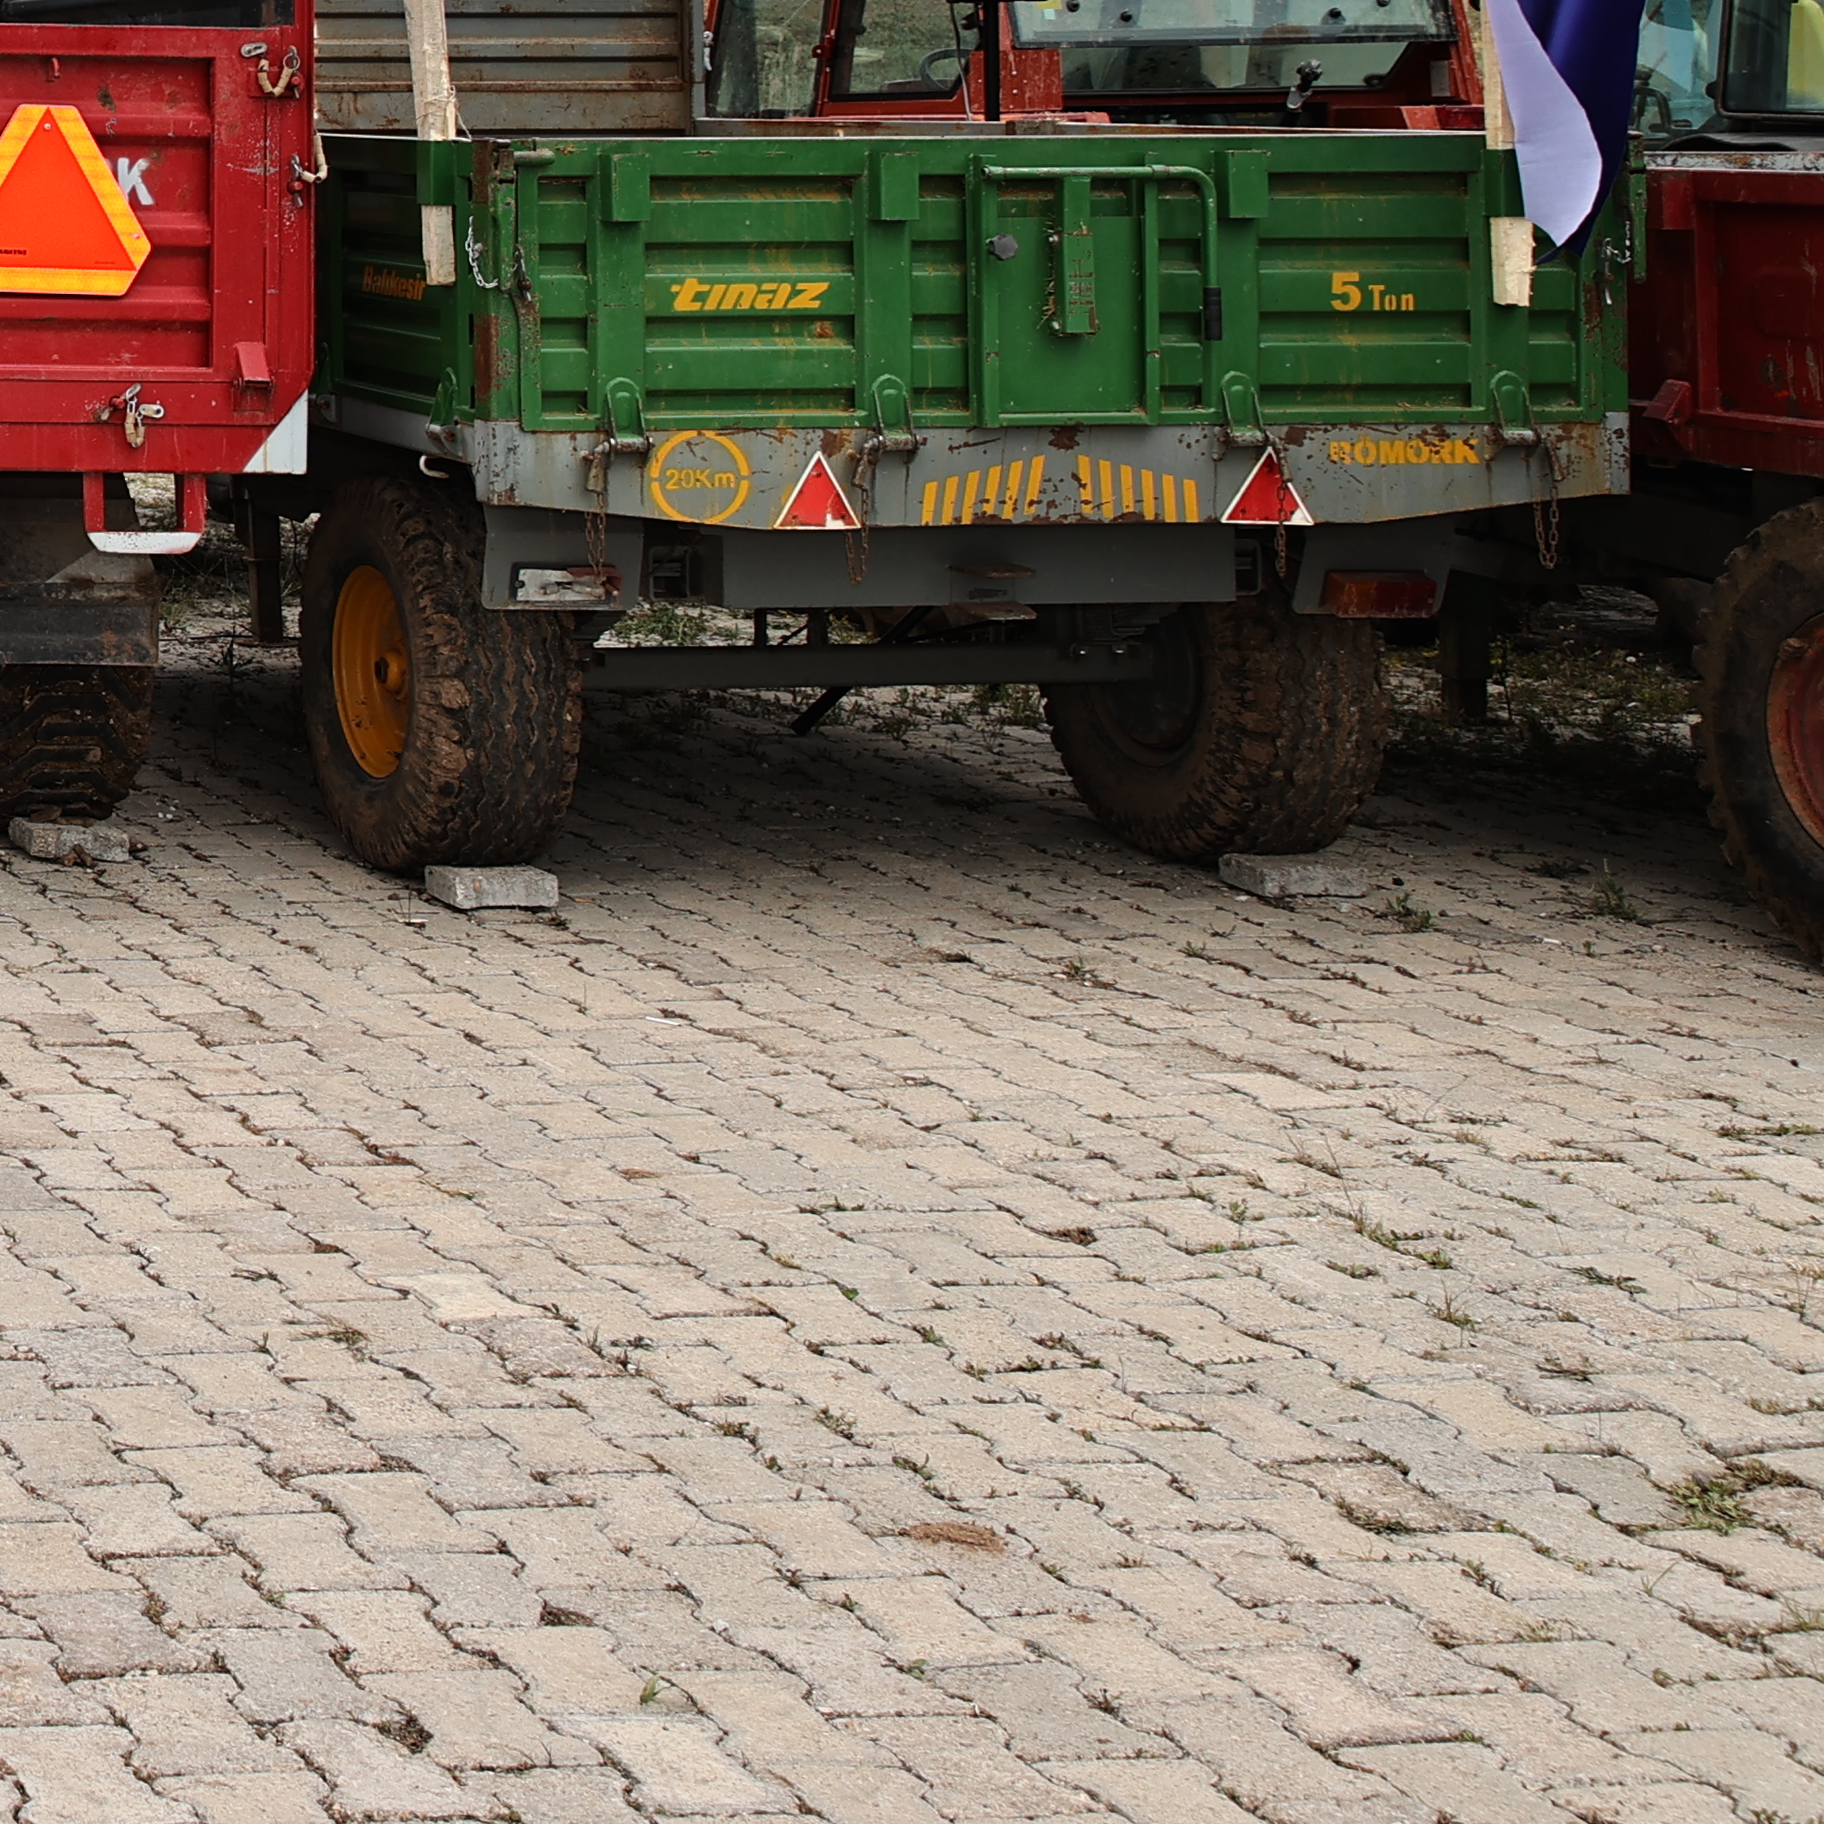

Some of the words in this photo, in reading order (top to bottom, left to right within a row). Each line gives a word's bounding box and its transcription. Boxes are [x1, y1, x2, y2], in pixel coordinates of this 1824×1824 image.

[1330, 271, 1362, 311] 5
[1368, 284, 1416, 311] Ton
[1329, 434, 1480, 465] RÖMORK
